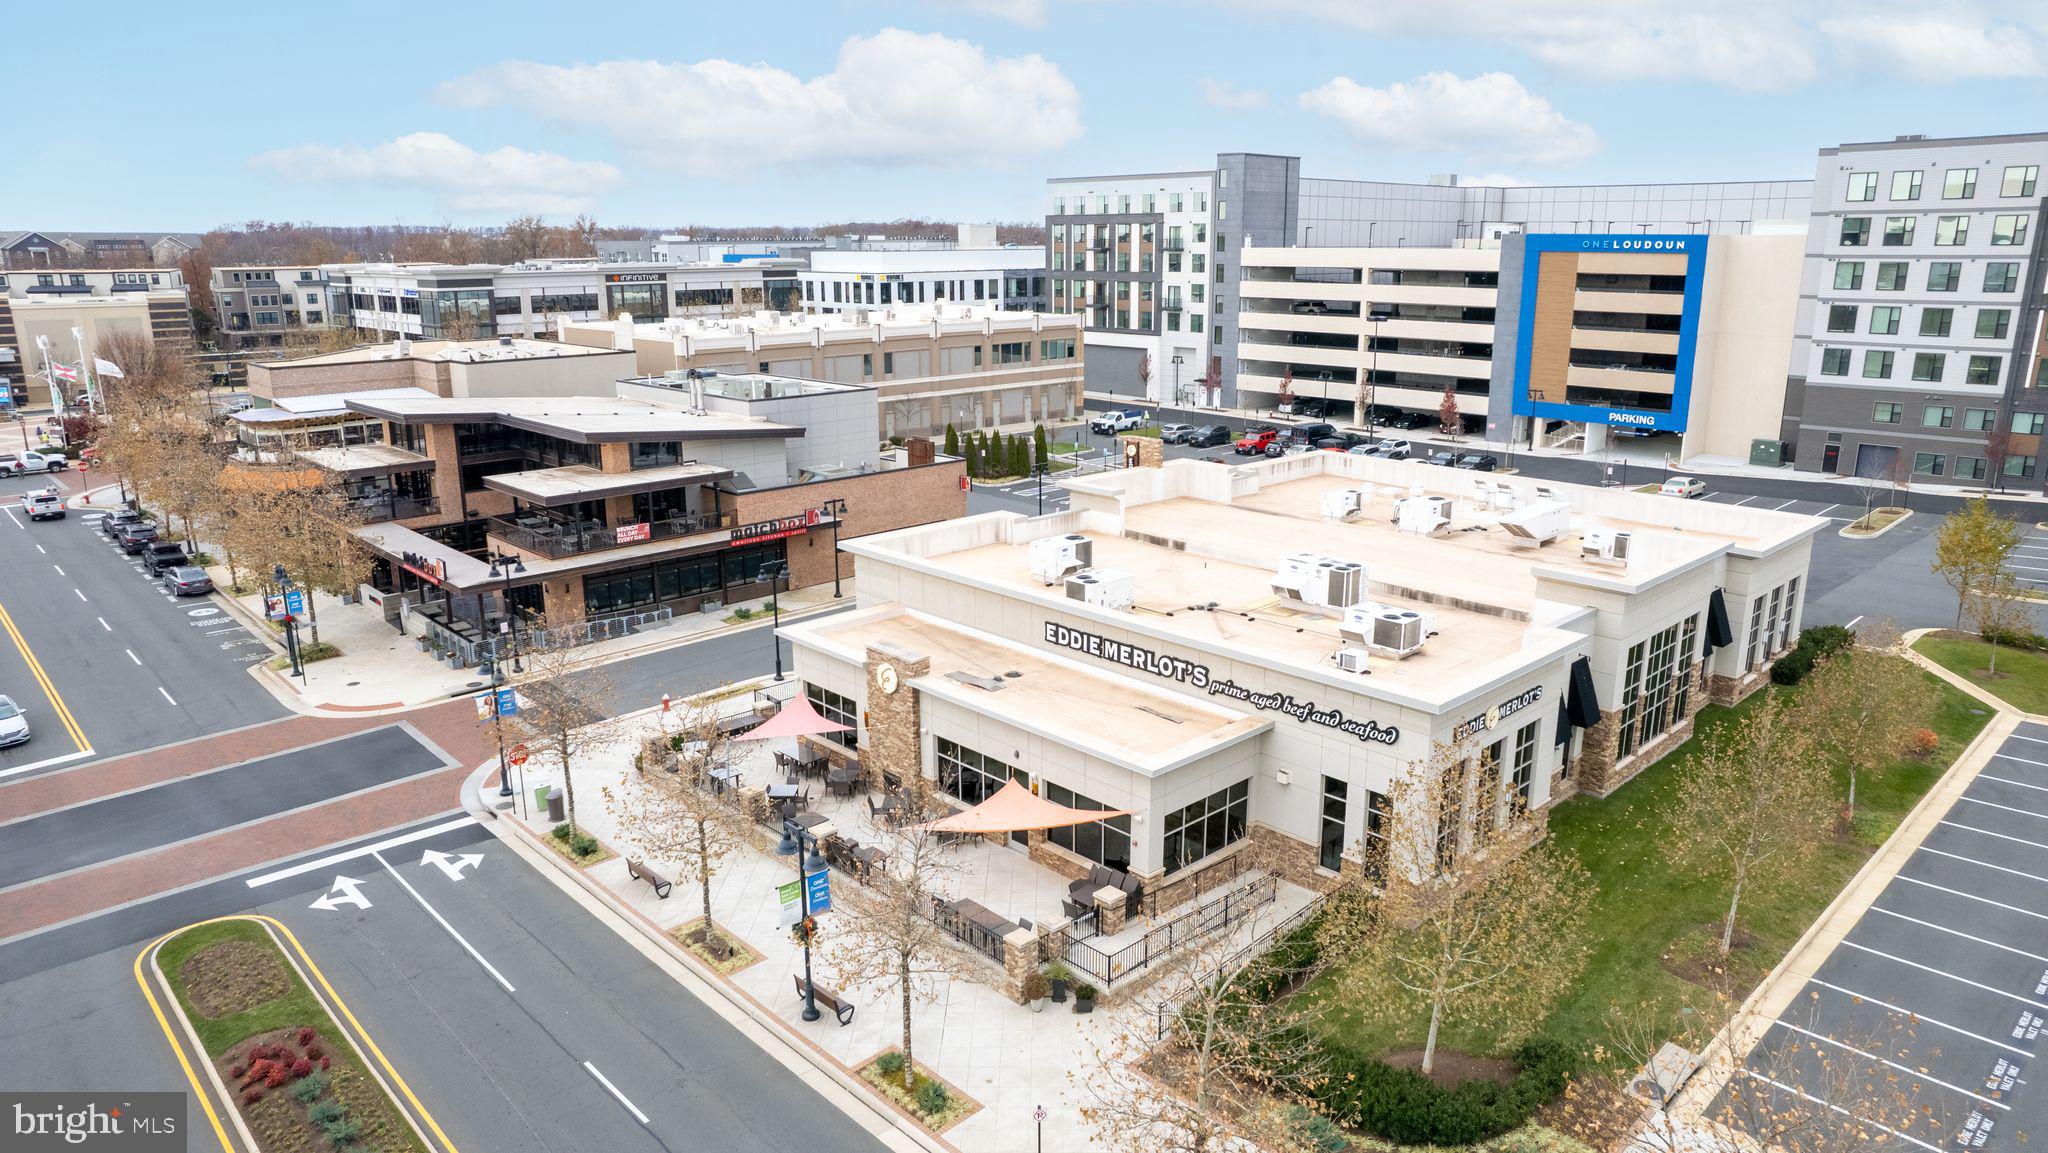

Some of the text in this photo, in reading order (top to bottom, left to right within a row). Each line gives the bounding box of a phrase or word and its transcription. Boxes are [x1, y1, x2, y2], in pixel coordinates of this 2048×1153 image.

[1609, 412, 1655, 426] PARKING
[617, 530, 628, 538] ALL
[731, 517, 805, 540] matchbox
[617, 533, 645, 544] EVERY DAY
[1045, 622, 1399, 745] EDDIE MERLOT'S prime aged beef and seafood
[1499, 686, 1542, 719] MERLOT'S
[813, 878, 825, 886] ONE
[814, 890, 825, 898] ONE
[1999, 1075, 2015, 1091] VALET
[1965, 1110, 1983, 1131] MERLOT
[1971, 1117, 1995, 1147] VALET ONLY
